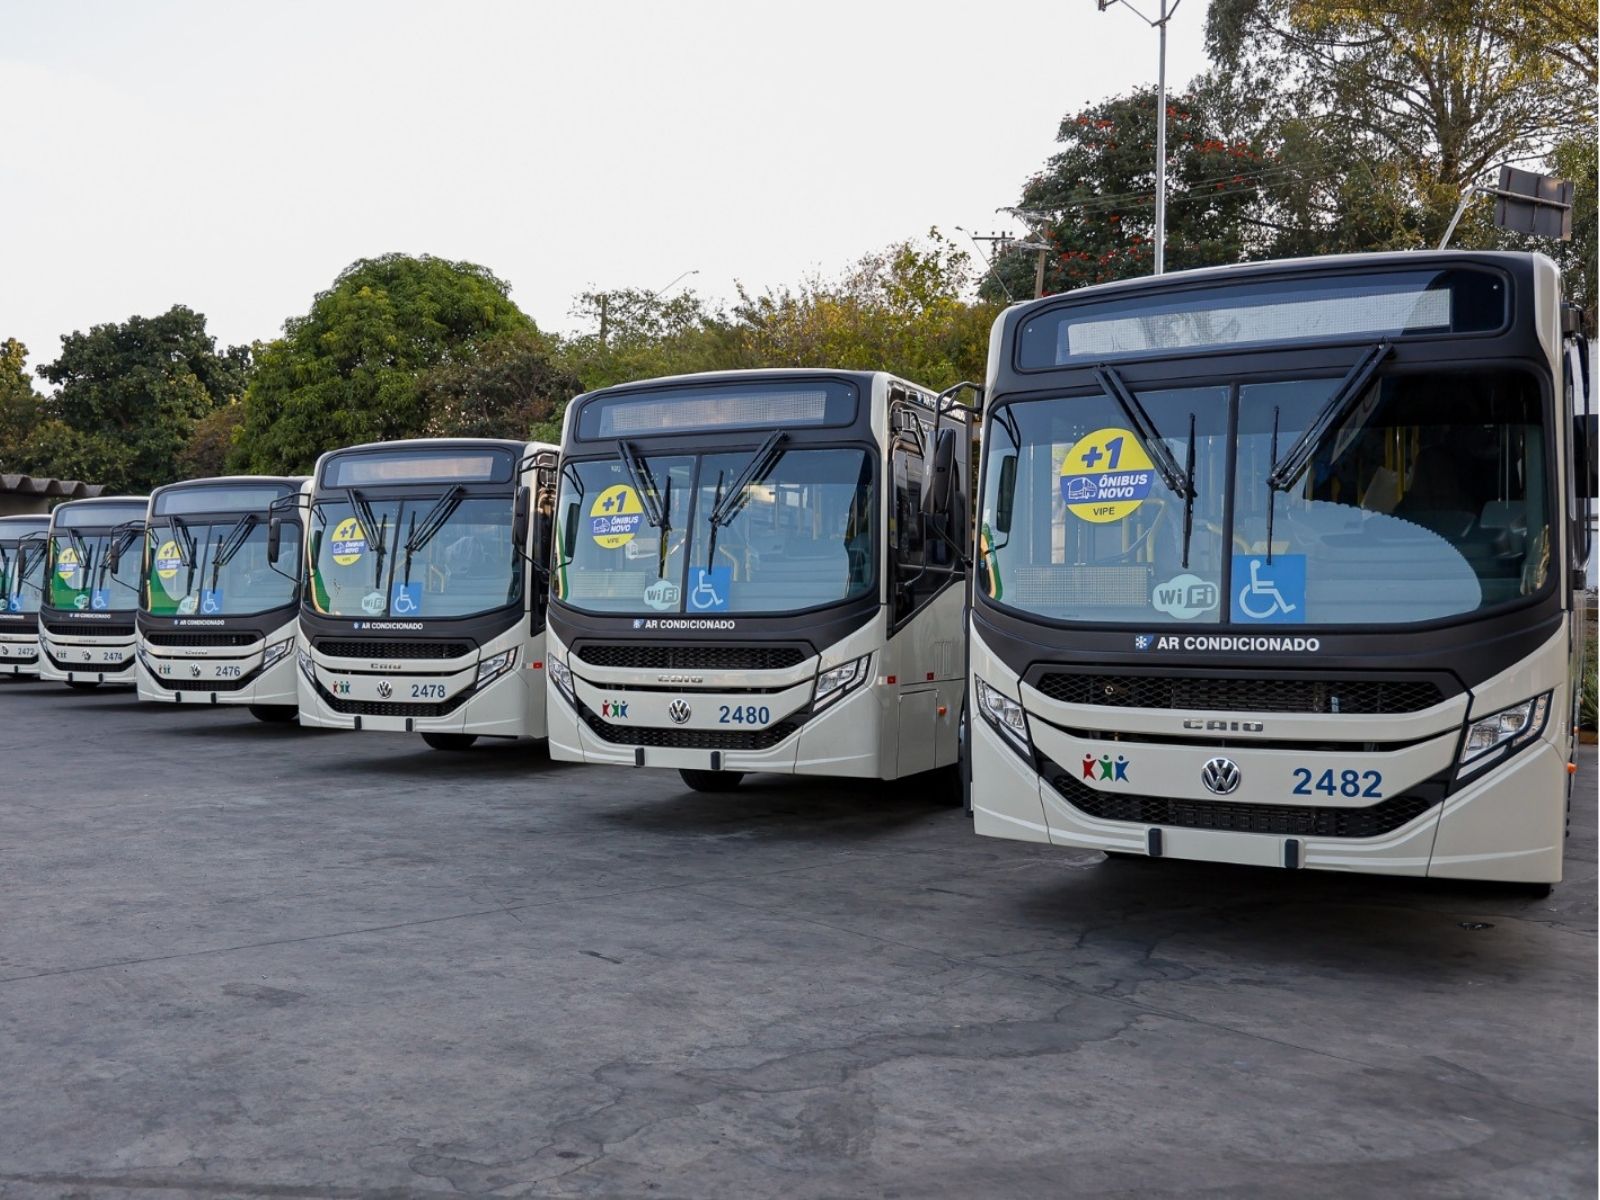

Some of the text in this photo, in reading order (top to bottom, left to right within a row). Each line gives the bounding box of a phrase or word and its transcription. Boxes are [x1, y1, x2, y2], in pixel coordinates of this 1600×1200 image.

[1081, 436, 1123, 469] +1
[1098, 474, 1148, 487] ÔNIBUS
[1098, 487, 1134, 499] NOVO
[602, 490, 627, 512] +1
[1093, 507, 1115, 515] VIPE
[340, 523, 357, 538] +1
[610, 525, 631, 533] NOVO
[371, 622, 423, 630] CONDICIONADO
[645, 620, 735, 629] AR CONDICIONADO
[1157, 637, 1320, 651] AR CONDICIONADO
[104, 652, 123, 661] 2474
[215, 665, 241, 677] 2476
[411, 684, 446, 698] 2478
[719, 705, 770, 724] 2480
[1183, 719, 1264, 732] CAIO
[1292, 767, 1383, 798] 2482
